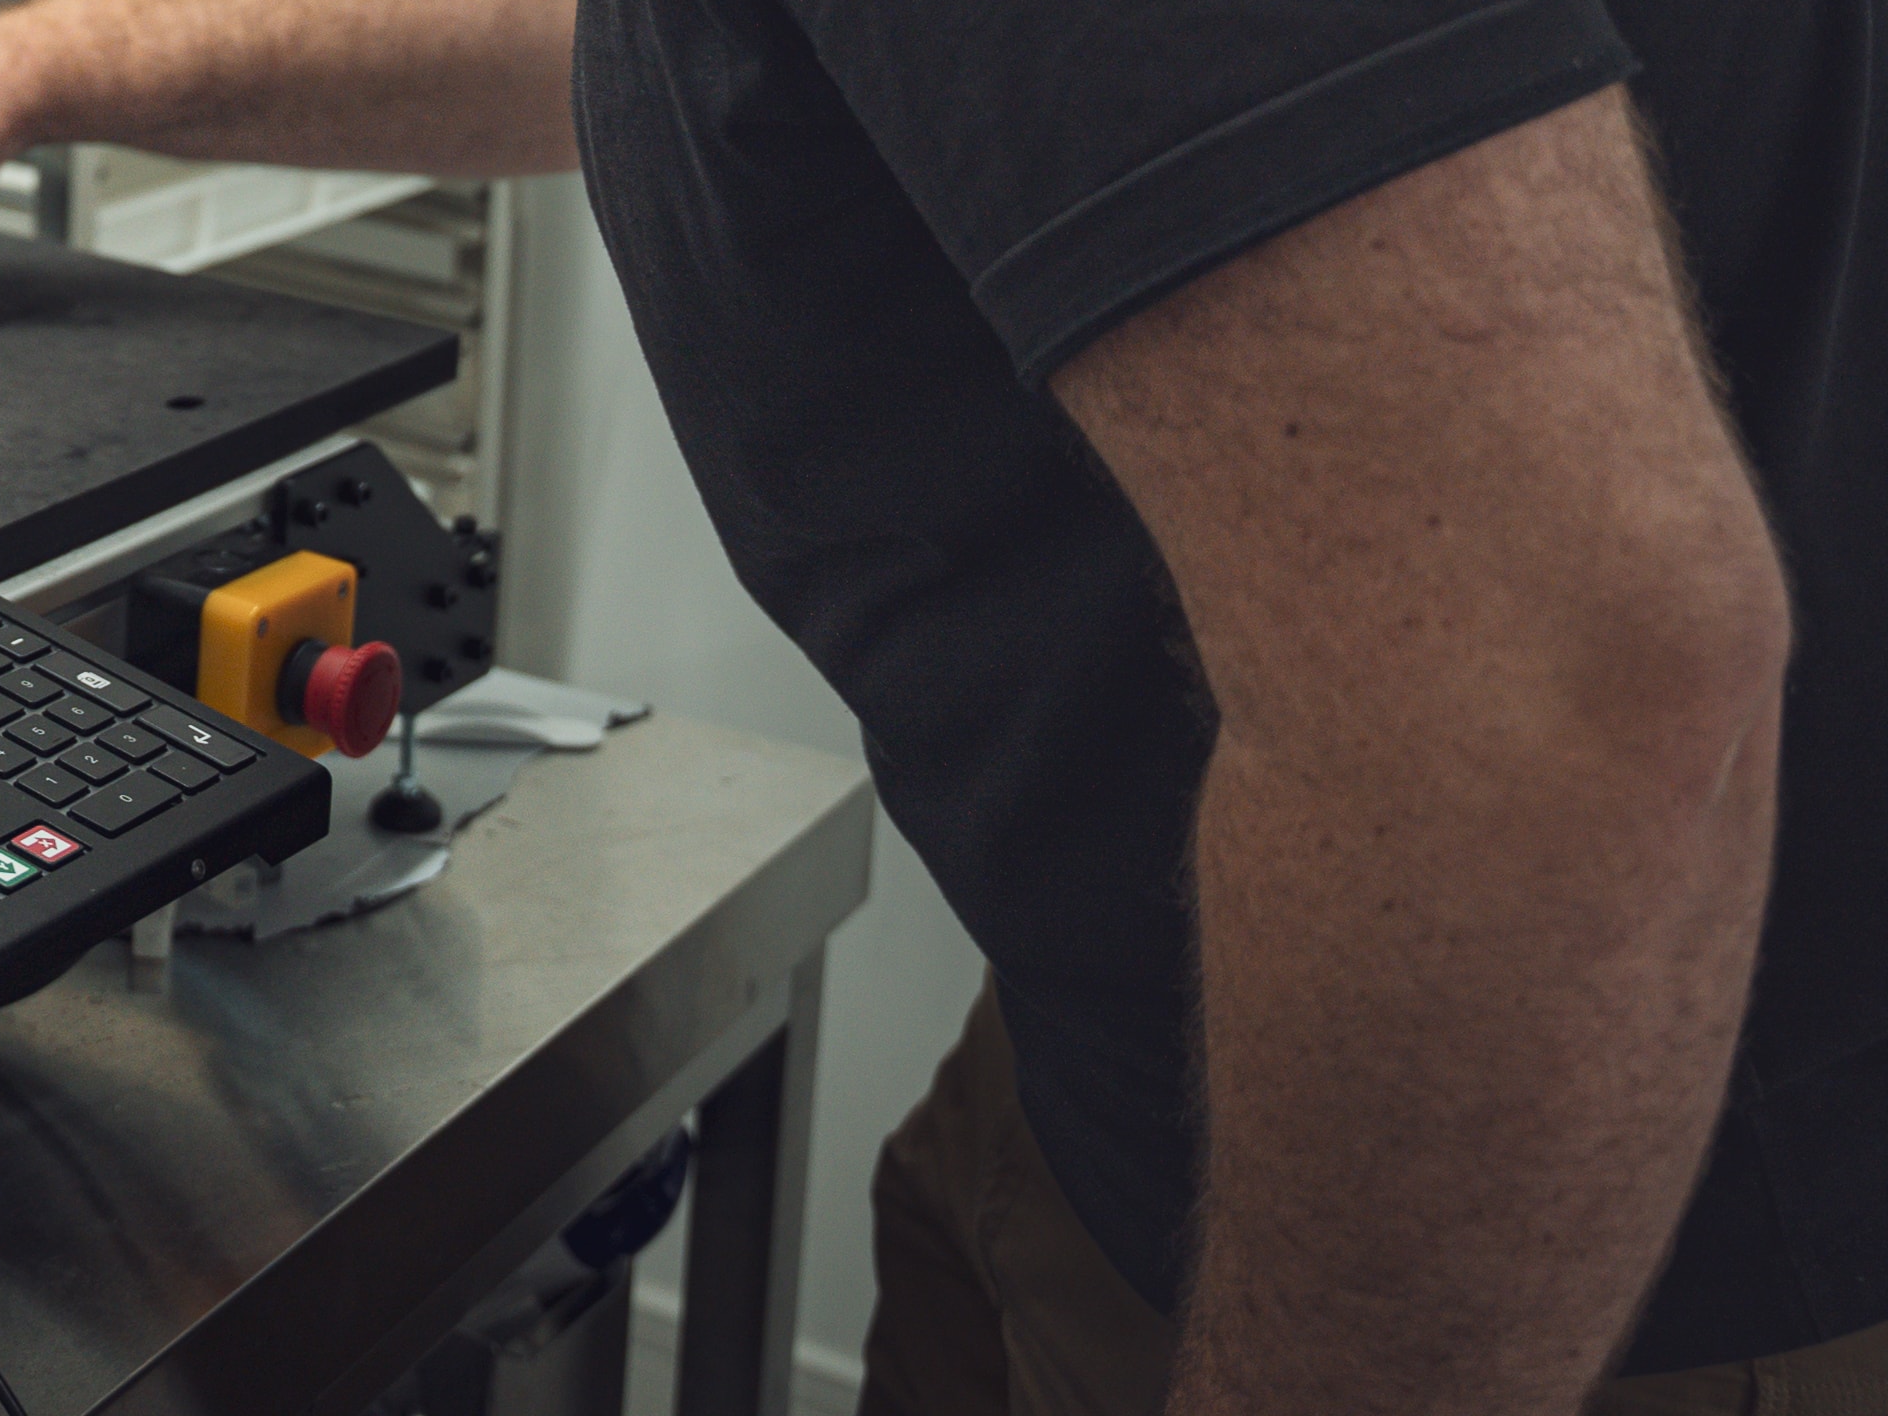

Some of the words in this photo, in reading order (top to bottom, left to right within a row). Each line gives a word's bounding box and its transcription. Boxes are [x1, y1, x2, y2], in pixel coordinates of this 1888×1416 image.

[21, 680, 34, 688] 9
[71, 706, 84, 715] 6
[32, 726, 45, 735] 5
[123, 735, 136, 743] 3
[84, 755, 98, 763] 2
[119, 794, 133, 803] 0
[38, 839, 53, 848] X
